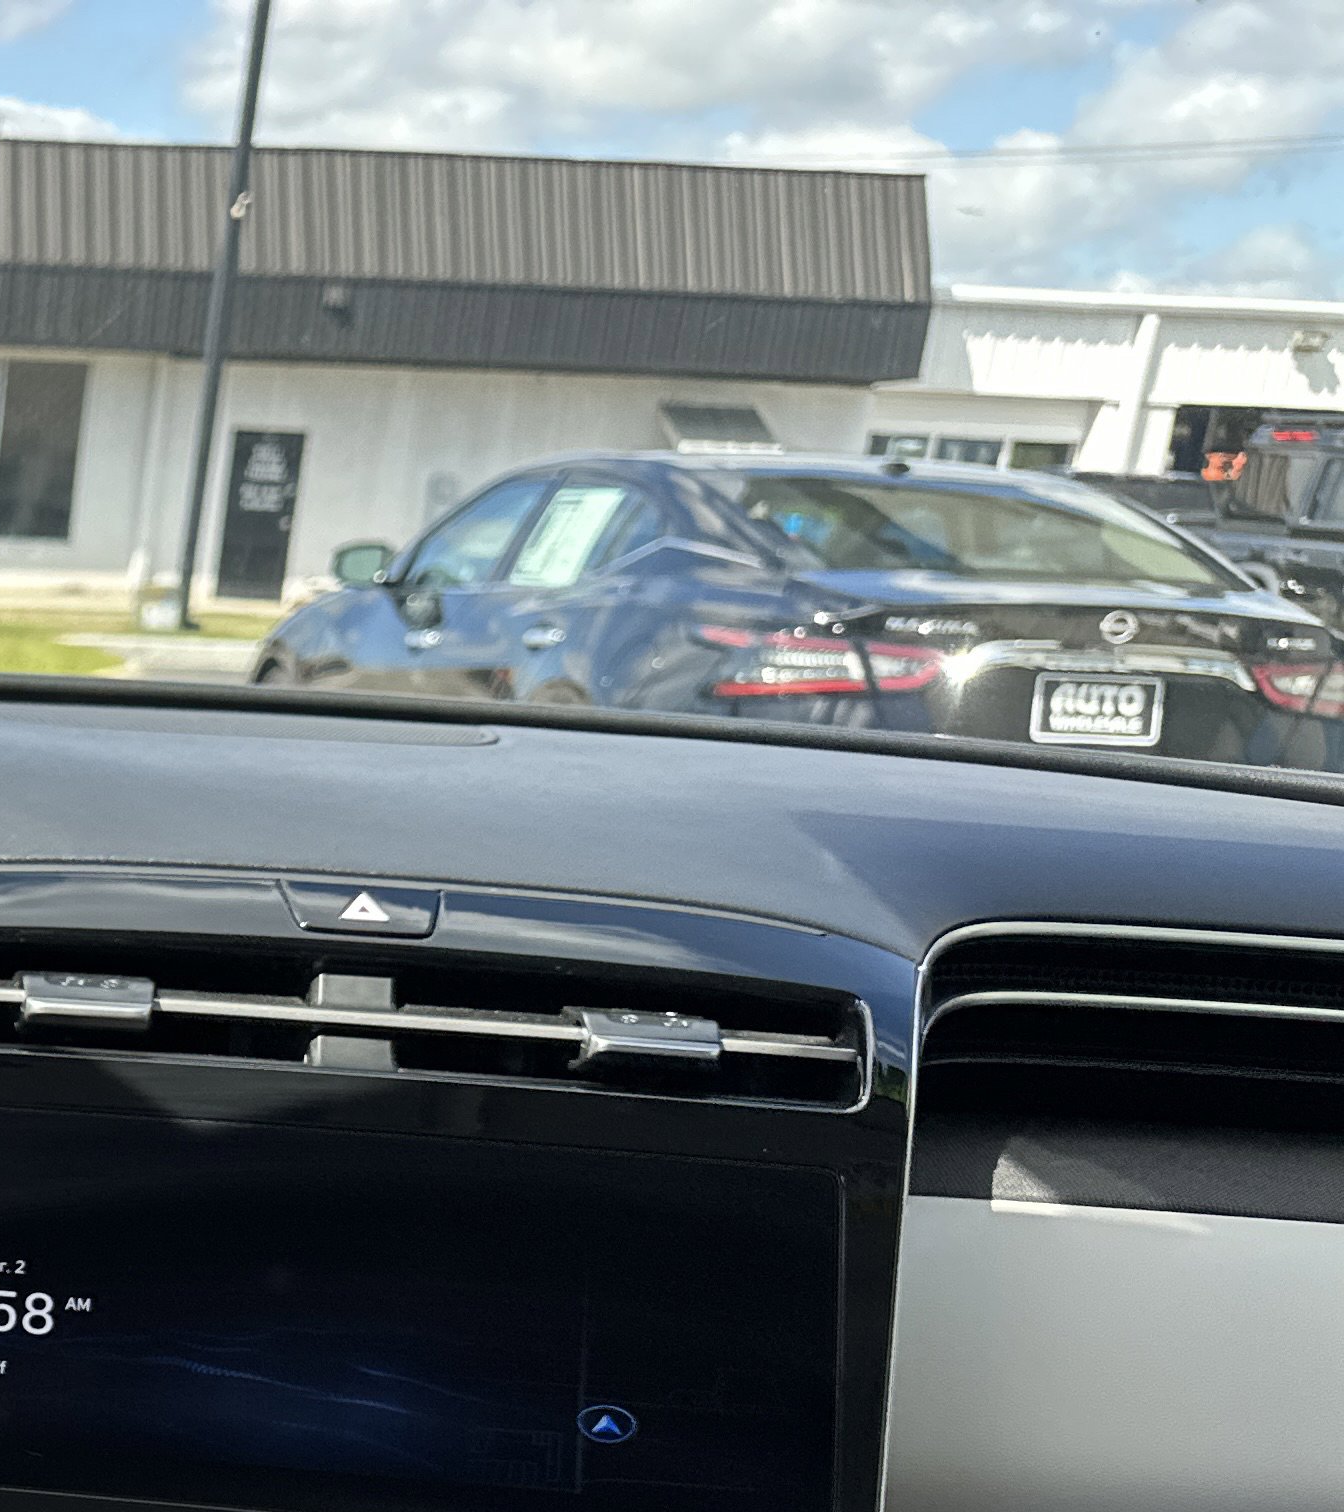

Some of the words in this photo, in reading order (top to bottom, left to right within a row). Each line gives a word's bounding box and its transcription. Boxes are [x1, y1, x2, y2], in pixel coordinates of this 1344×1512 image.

[1050, 682, 1146, 717] AUTO
[14, 1260, 26, 1275] 2
[64, 1297, 92, 1312] AM
